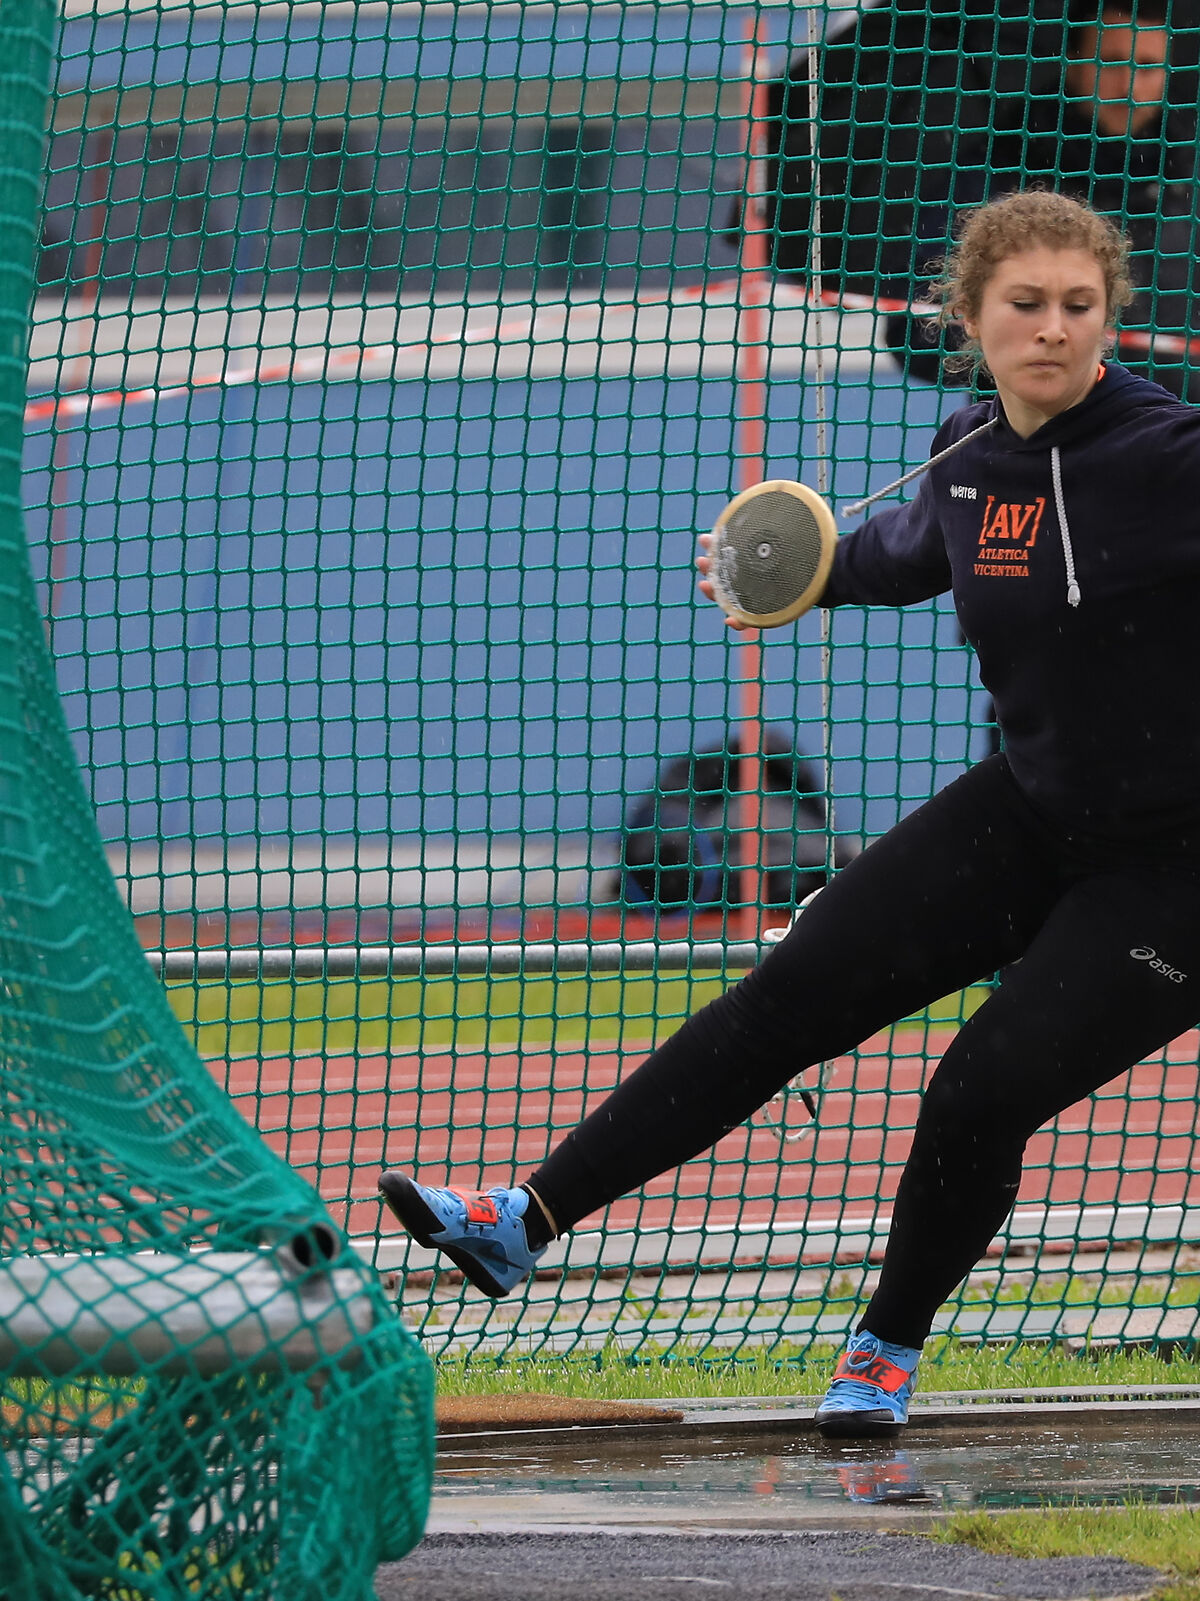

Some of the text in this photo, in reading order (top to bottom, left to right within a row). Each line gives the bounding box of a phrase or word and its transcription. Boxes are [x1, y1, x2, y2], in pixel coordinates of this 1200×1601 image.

[977, 548, 1029, 561] ATLETICA
[973, 564, 1030, 577] VICENTINA
[1149, 958, 1187, 983] asics
